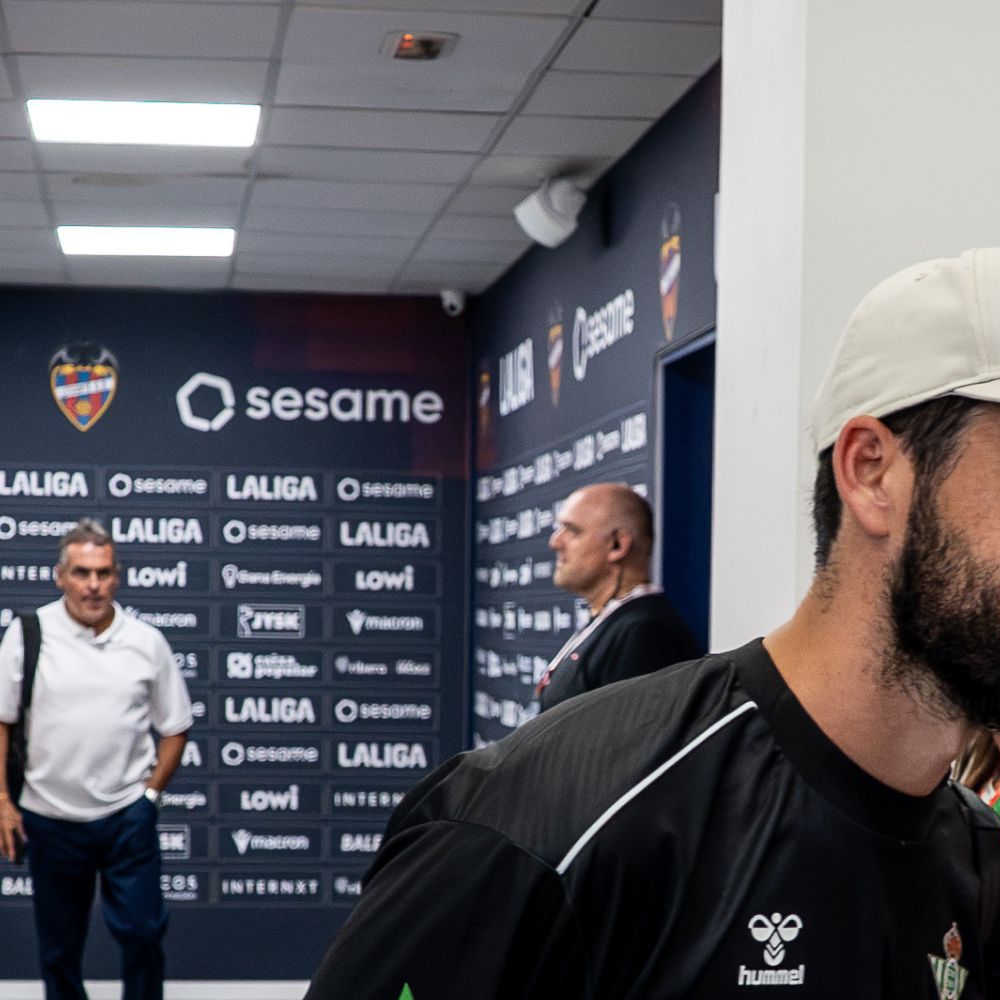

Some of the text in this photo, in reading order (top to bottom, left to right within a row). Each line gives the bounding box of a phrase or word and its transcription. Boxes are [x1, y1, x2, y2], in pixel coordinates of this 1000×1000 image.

[245, 385, 444, 424] sesame
[0, 470, 89, 497] LALIGA
[133, 477, 208, 494] sesame
[227, 474, 317, 500] LALIGA
[362, 481, 434, 499] sesame
[17, 520, 78, 537] sesam
[112, 517, 203, 544] LALIGA
[248, 524, 321, 541] sesame
[340, 521, 430, 548] LALIGA
[225, 697, 316, 723] LALIGA
[359, 703, 432, 720] sesame
[246, 746, 319, 762] sesame
[338, 742, 428, 768] LALIGA
[334, 792, 404, 807] INTERN
[159, 832, 187, 851] SK
[251, 835, 310, 850] macron
[222, 879, 319, 895] INTERNXT
[738, 964, 805, 985] hummel
